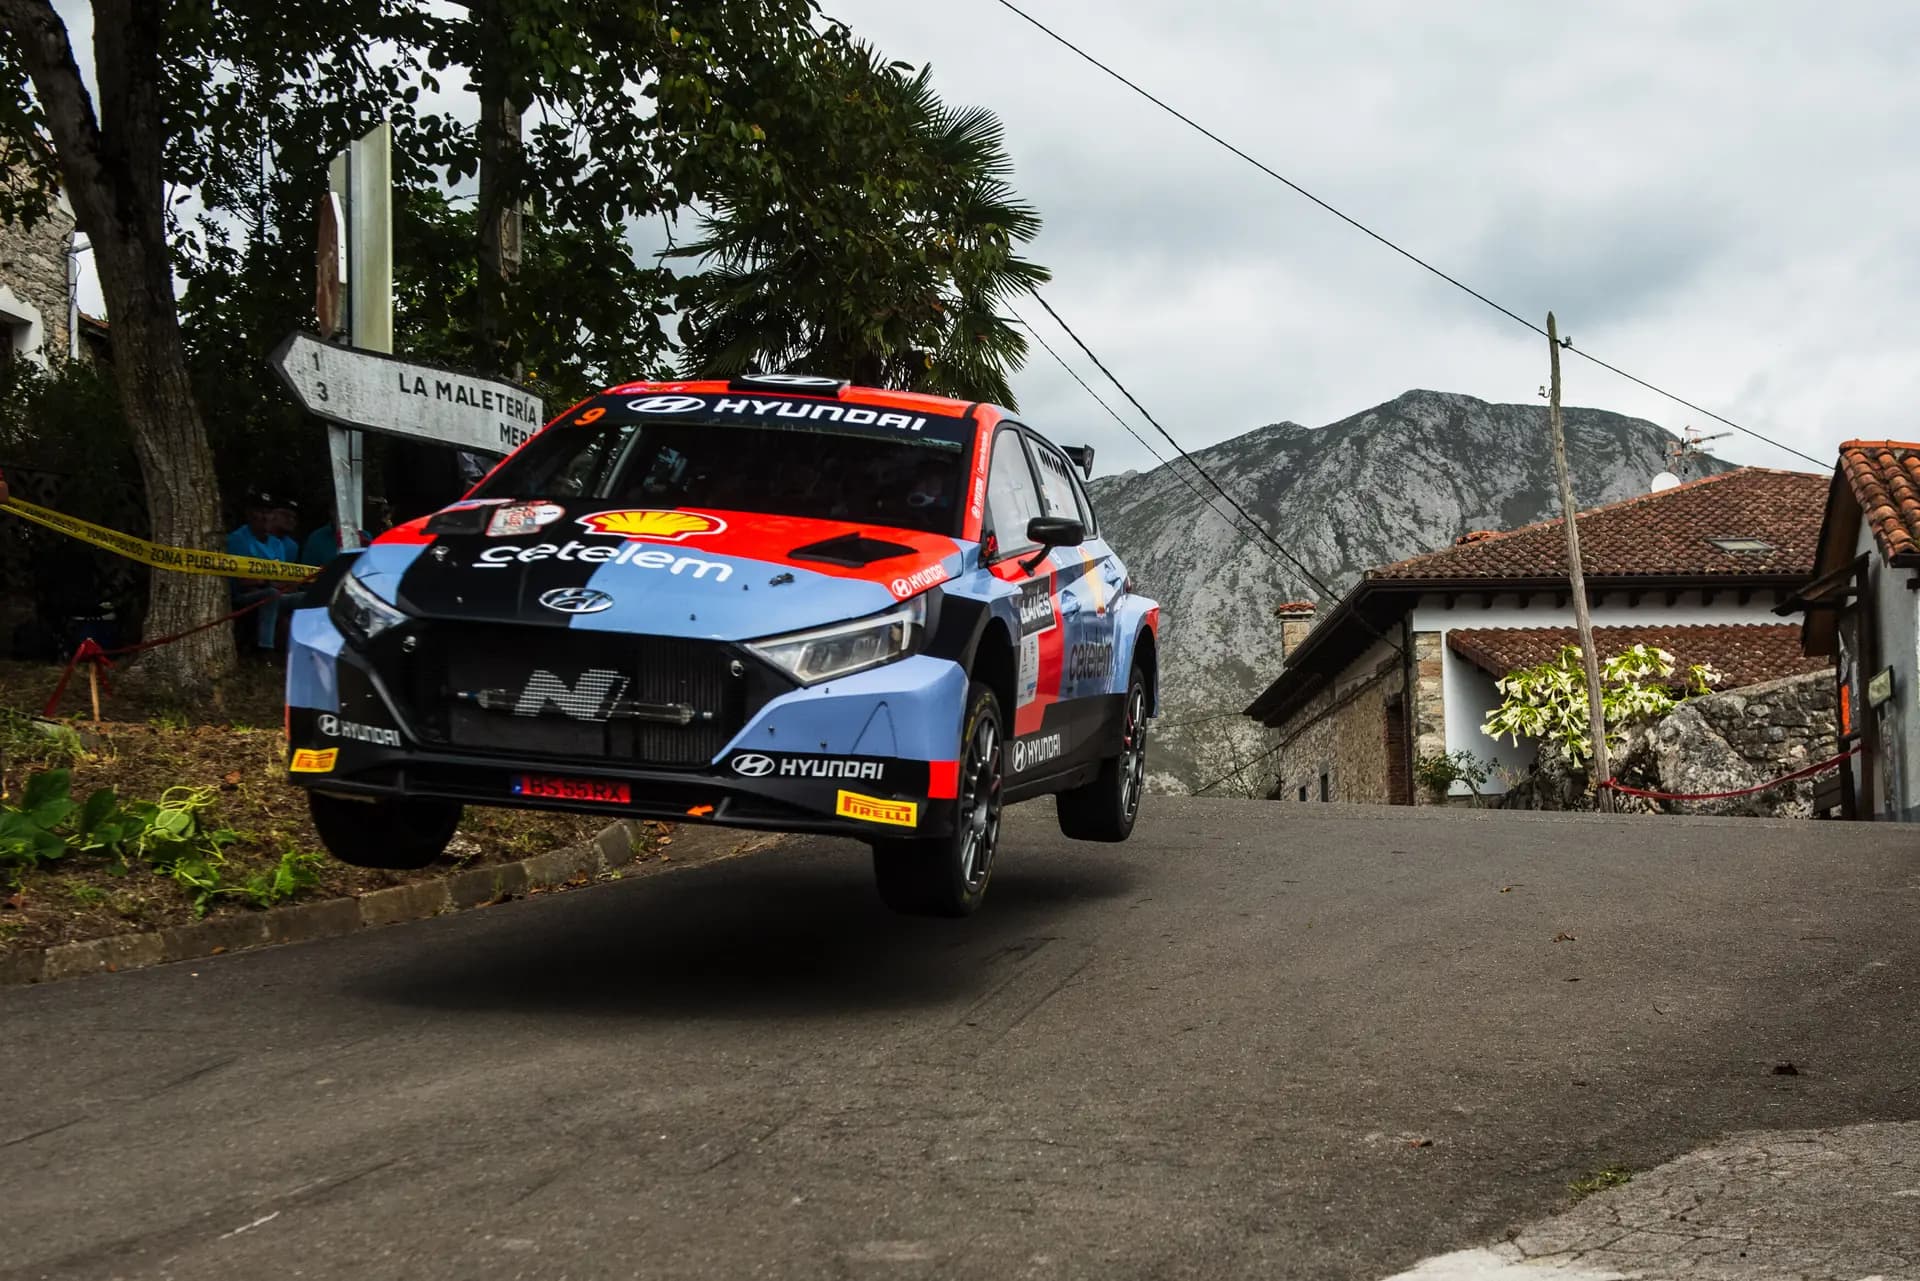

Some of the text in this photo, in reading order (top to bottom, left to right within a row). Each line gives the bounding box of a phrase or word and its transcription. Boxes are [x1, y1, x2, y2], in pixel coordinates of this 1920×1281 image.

[312, 352, 537, 426] 1 LA MALETERÍA
[317, 382, 329, 402] 3
[574, 407, 607, 426] 9
[713, 398, 927, 432] HYUNDAI
[150, 547, 182, 567] ZONA
[248, 560, 278, 577] ZONA
[477, 541, 733, 583] cetelem
[341, 720, 401, 747] HYUNDAI
[1027, 732, 1061, 765] HYUNDAI
[780, 758, 884, 780] HYUNDAI
[843, 796, 911, 823] PIRELLI
